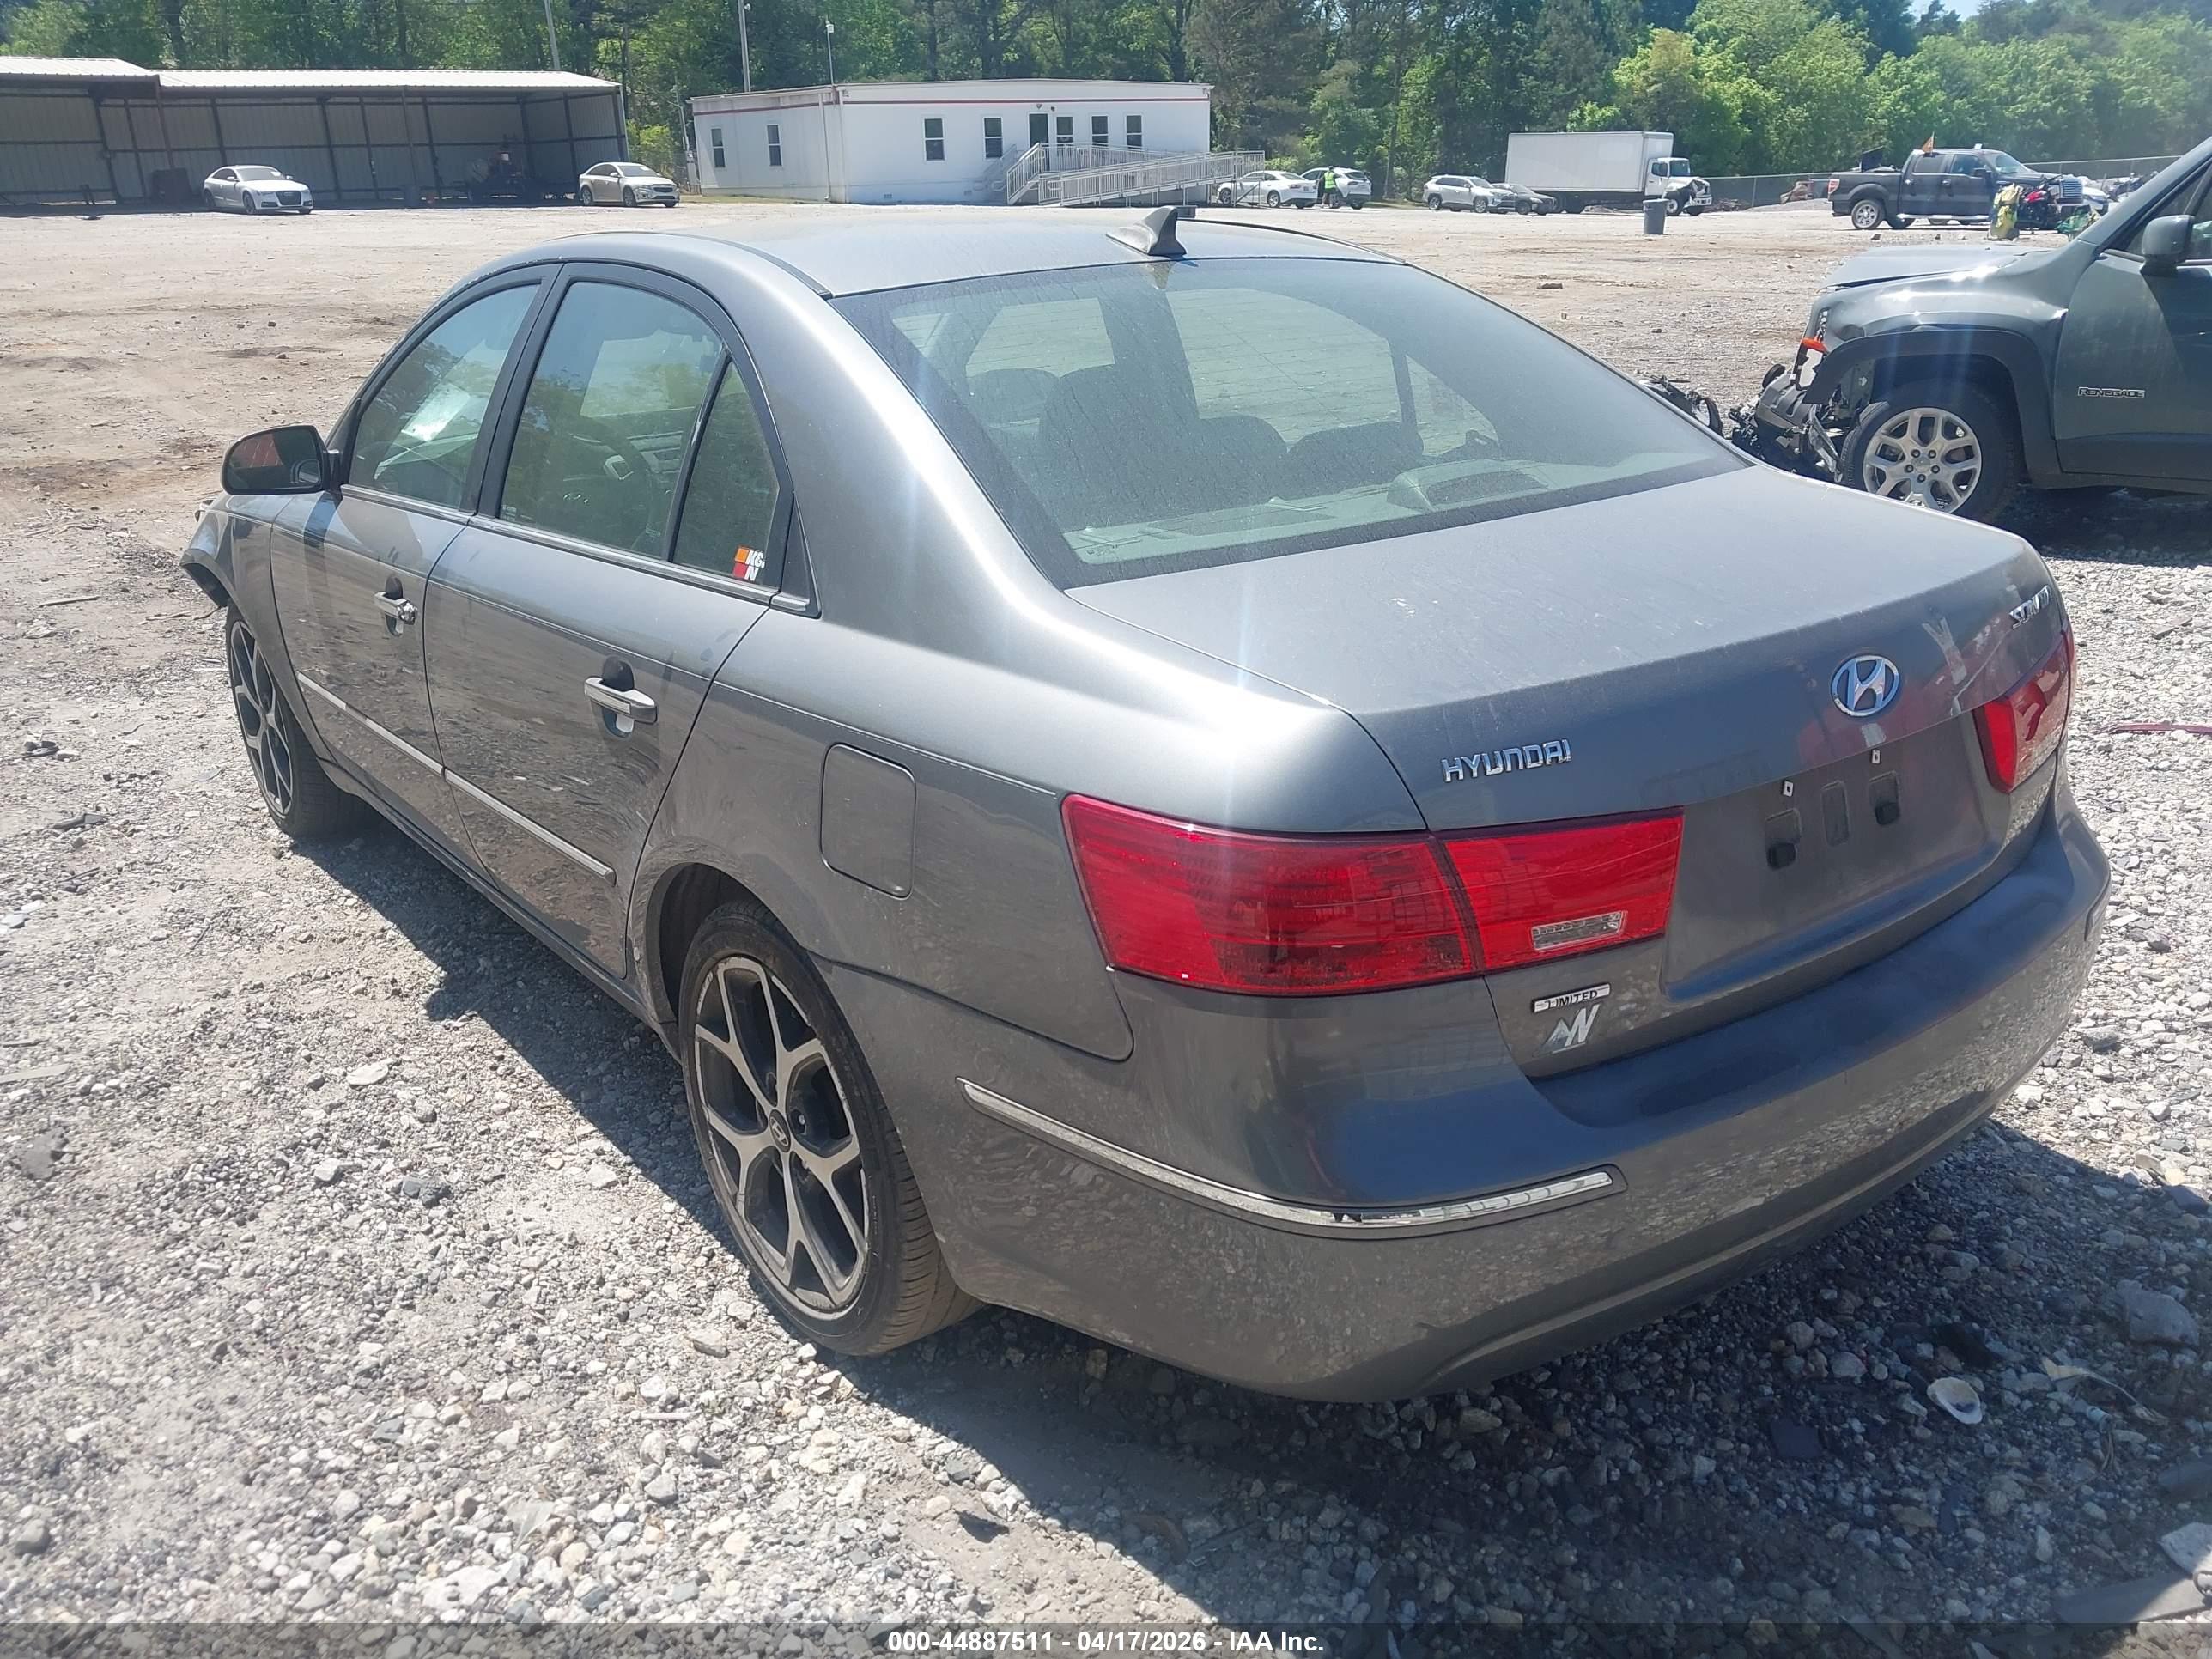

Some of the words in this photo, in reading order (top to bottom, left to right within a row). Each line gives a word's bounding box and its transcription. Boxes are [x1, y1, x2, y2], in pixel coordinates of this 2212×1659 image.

[2078, 386, 2145, 398] RENEGADE
[1441, 738, 1571, 782] HYUNDAI
[1545, 989, 1598, 1009] LIMITED
